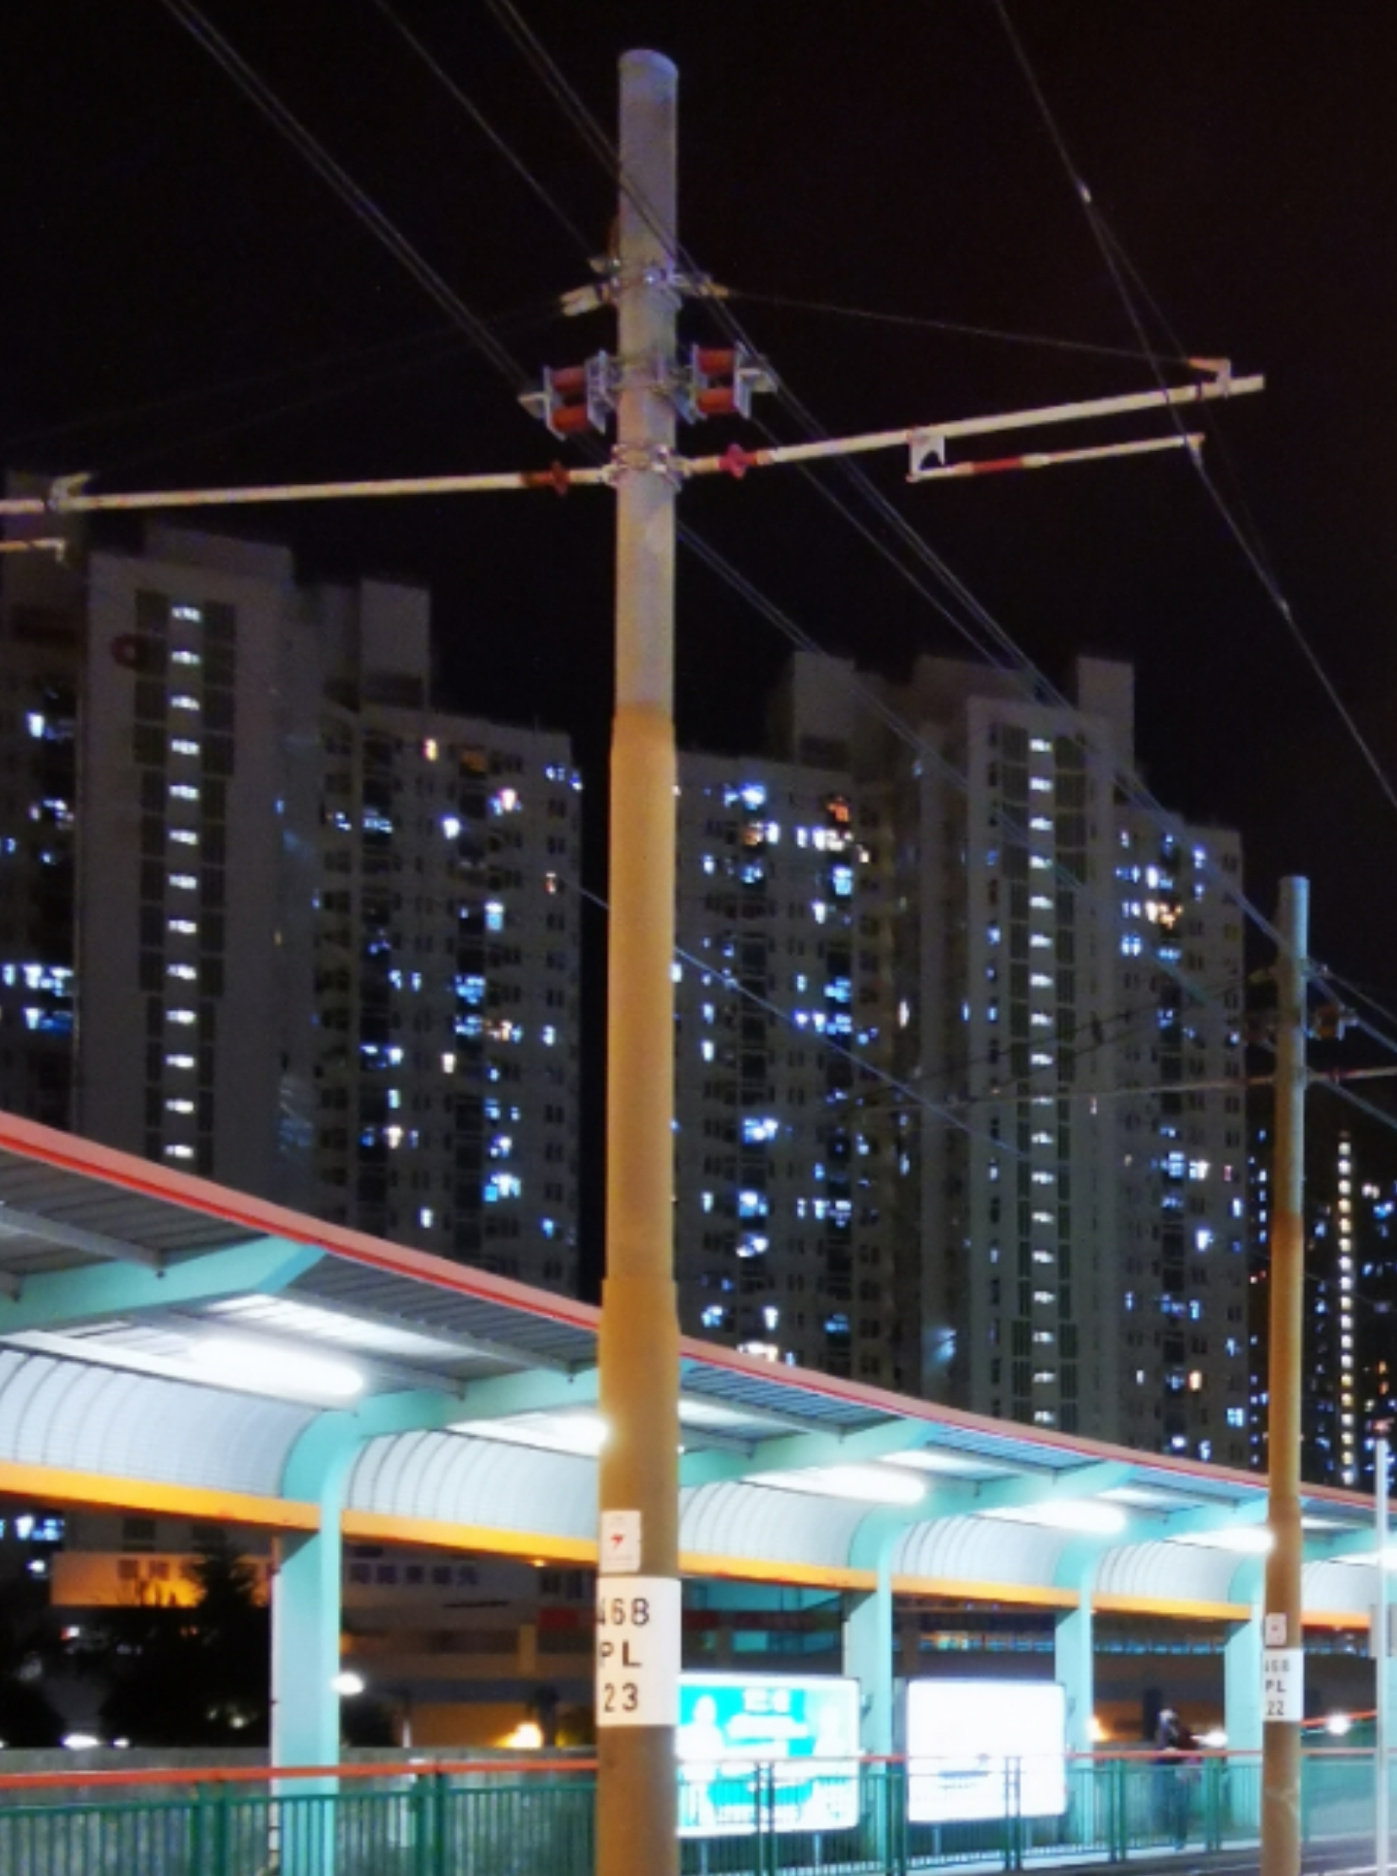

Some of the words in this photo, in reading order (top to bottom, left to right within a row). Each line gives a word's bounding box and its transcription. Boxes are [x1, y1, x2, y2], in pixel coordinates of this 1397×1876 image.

[600, 1640, 642, 1668] PL
[603, 1681, 639, 1713] 23
[1265, 1679, 1287, 1693] PL
